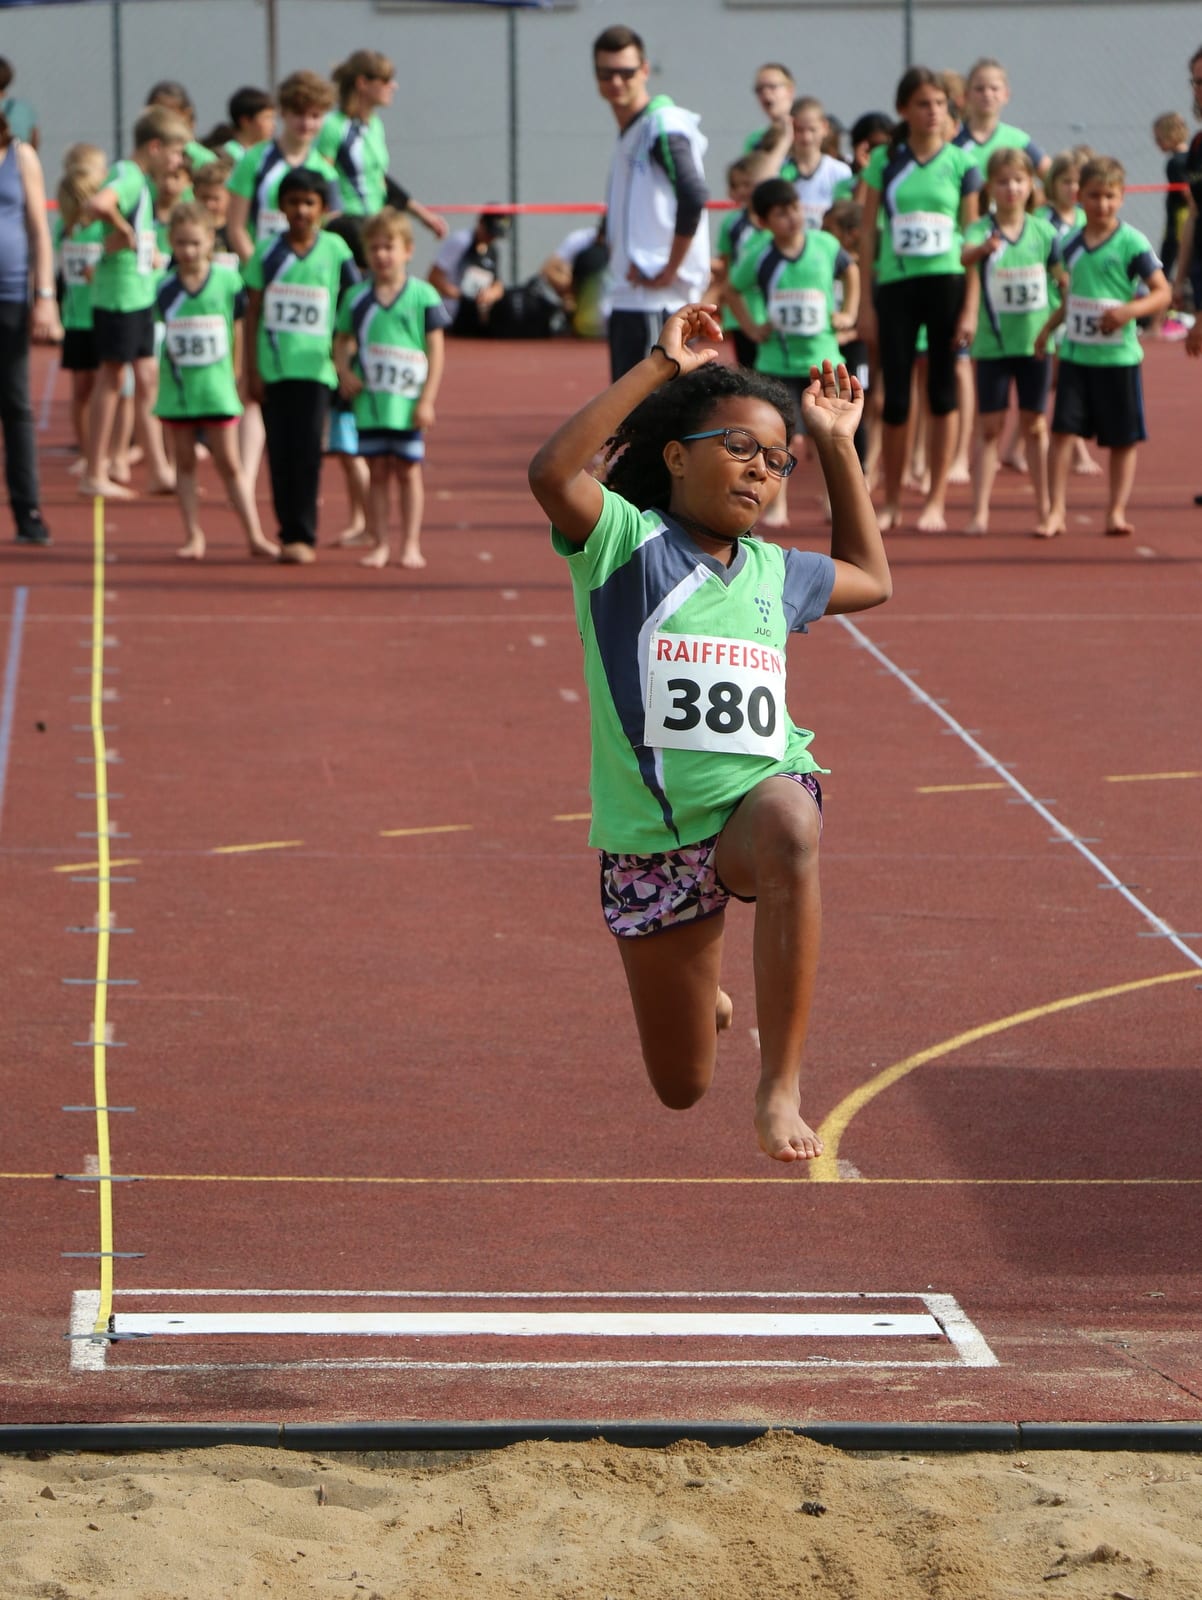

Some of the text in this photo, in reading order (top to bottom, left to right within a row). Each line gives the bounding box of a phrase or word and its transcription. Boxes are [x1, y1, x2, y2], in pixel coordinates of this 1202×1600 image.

[900, 227, 941, 247] 291
[1003, 284, 1042, 305] 132
[273, 301, 319, 325] 120
[779, 307, 818, 327] 133
[174, 334, 217, 357] 381
[374, 363, 415, 390] 119
[657, 639, 782, 675] RAIFFEISEN
[663, 678, 776, 738] 380
